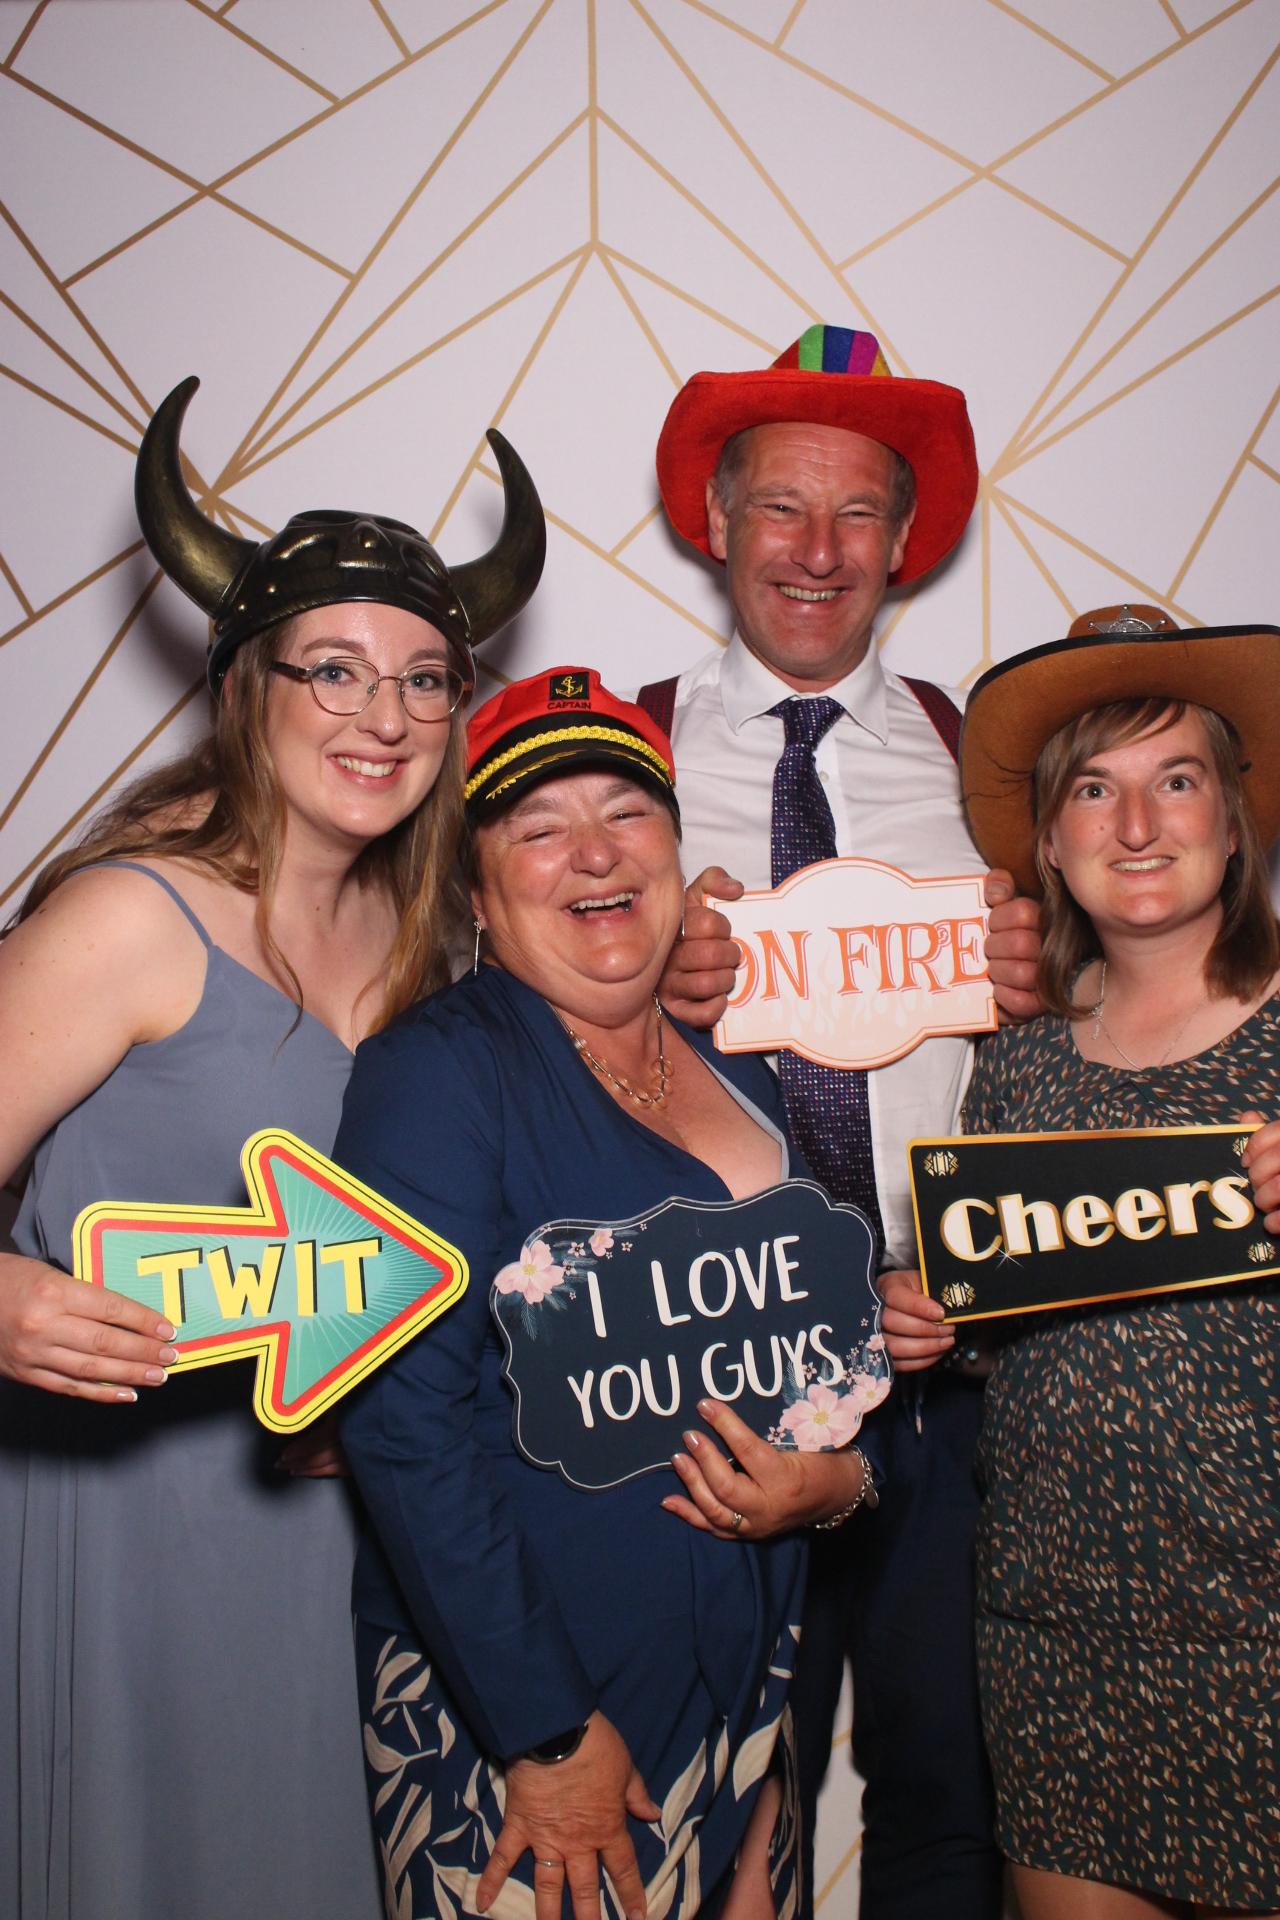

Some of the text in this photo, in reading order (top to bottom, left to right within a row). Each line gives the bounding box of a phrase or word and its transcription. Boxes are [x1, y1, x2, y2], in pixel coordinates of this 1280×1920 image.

[547, 701, 592, 710] CAPTAIN
[828, 916, 991, 996] FIRE
[939, 1175, 1255, 1262] Cheers
[136, 1236, 383, 1327] TWIT
[587, 1235, 809, 1338] I LOVE
[567, 1324, 845, 1428] YOU GUYS
